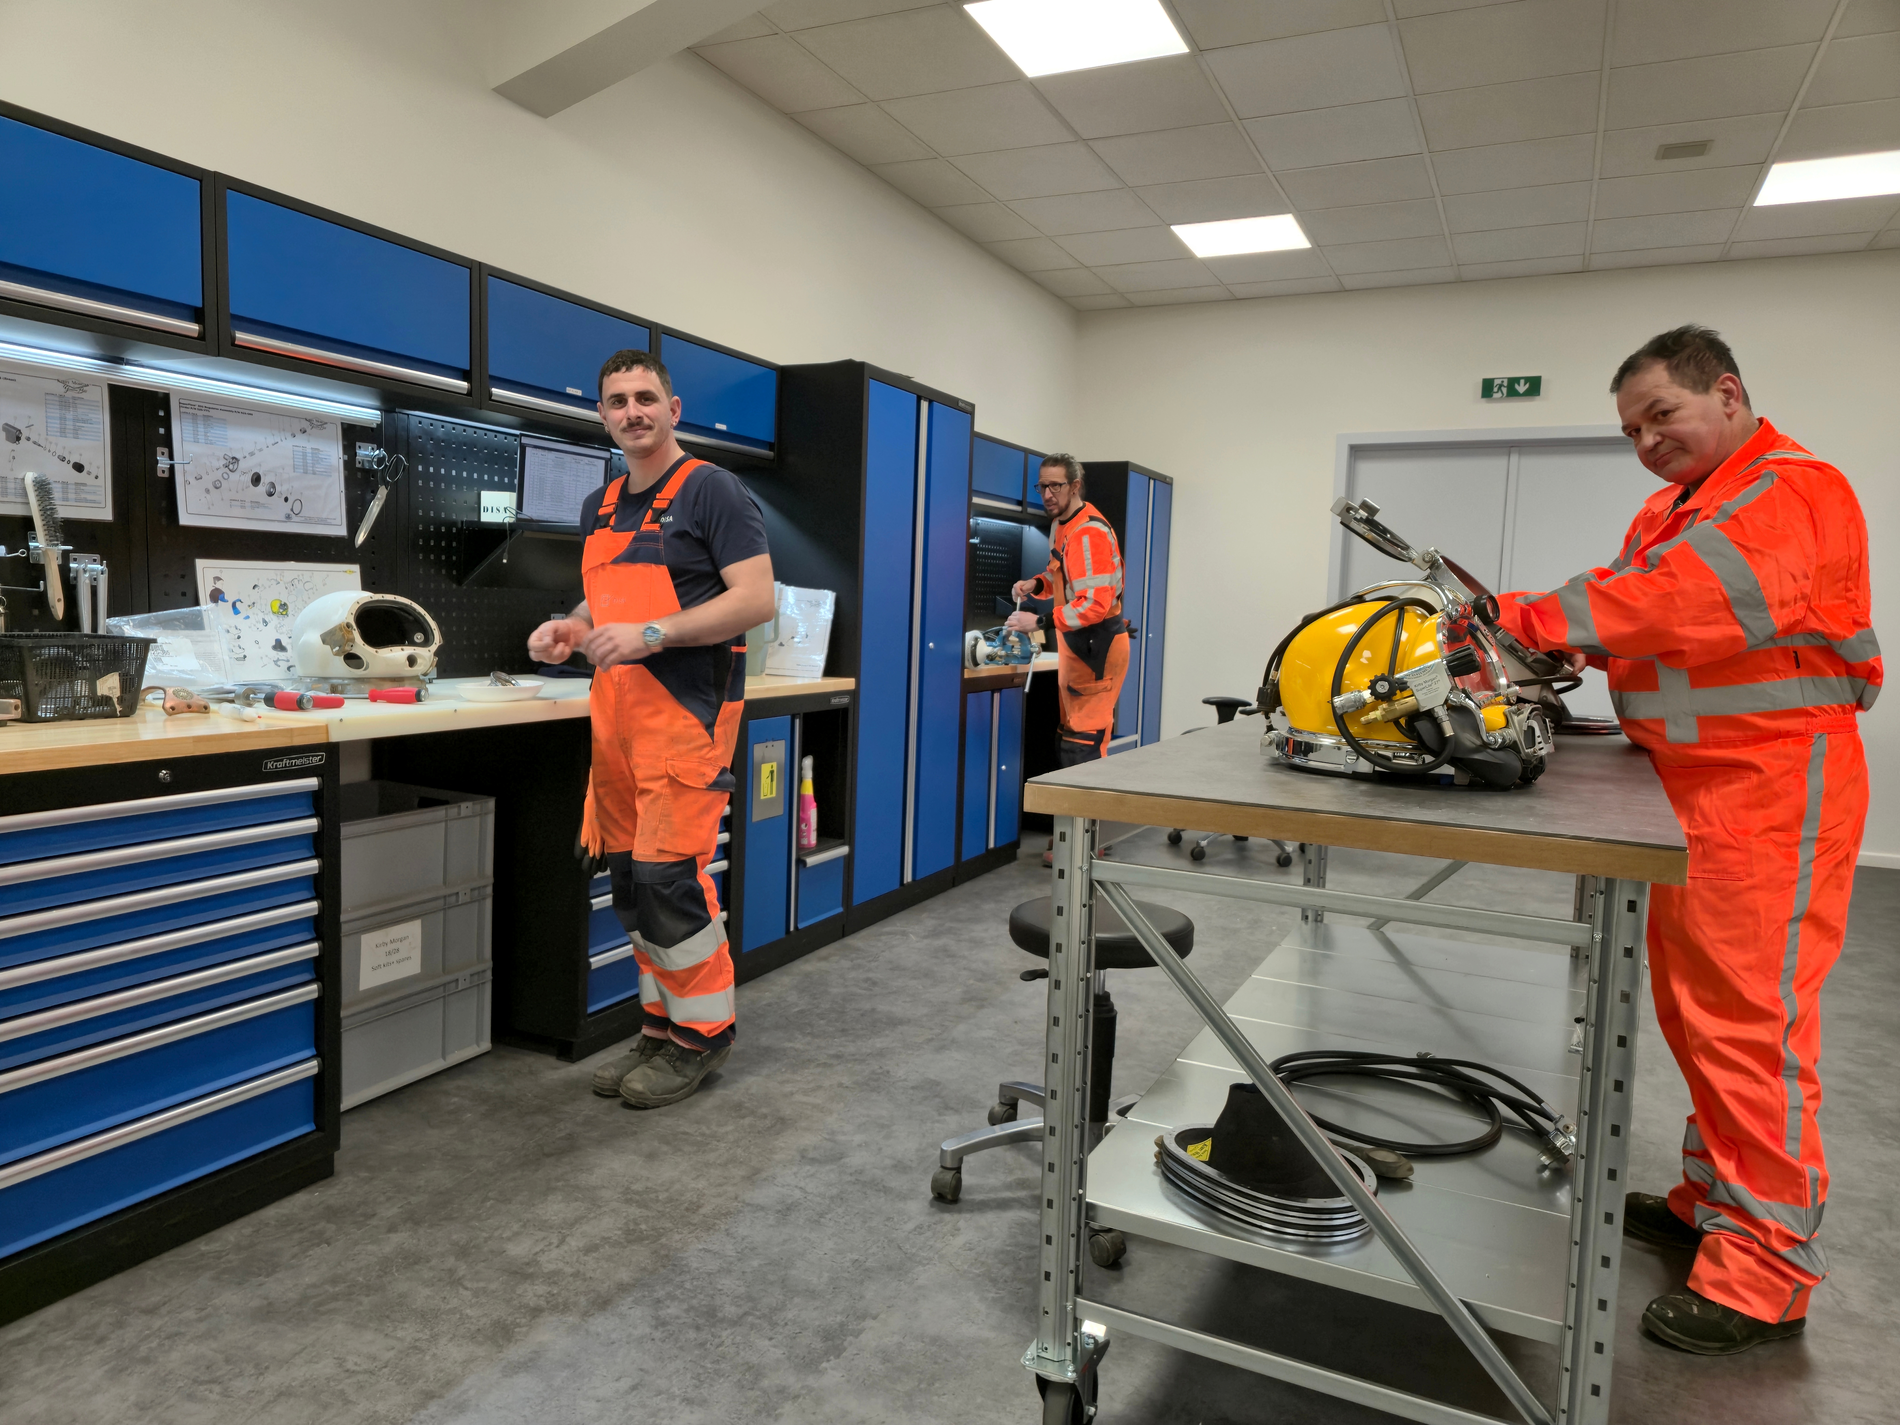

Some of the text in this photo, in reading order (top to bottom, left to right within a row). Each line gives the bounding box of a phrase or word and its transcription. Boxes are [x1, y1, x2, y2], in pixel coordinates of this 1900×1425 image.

[482, 505, 508, 514] DISA
[267, 756, 322, 769] Kraftmeister
[390, 935, 409, 944] Morgan
[396, 956, 412, 964] spares
